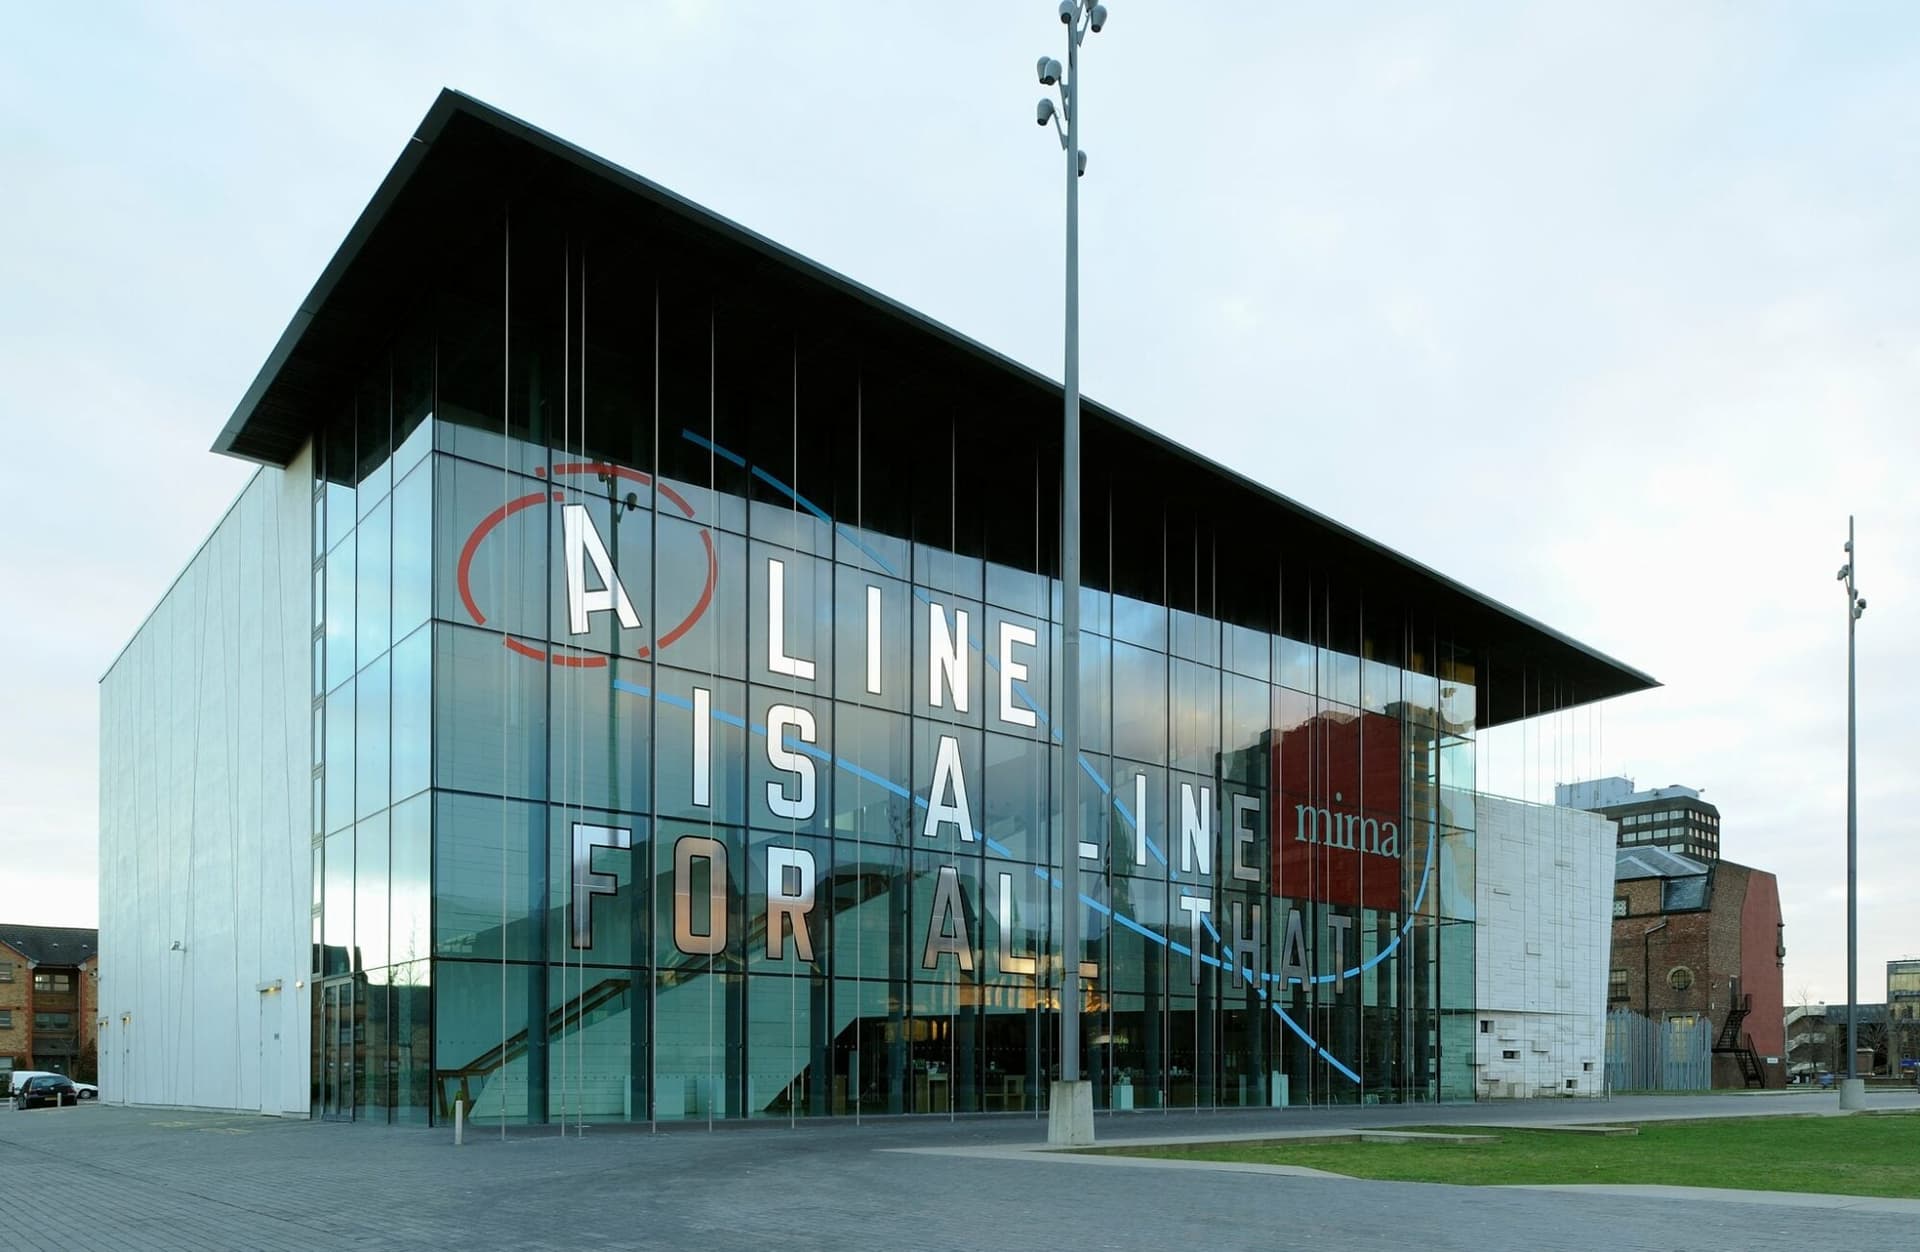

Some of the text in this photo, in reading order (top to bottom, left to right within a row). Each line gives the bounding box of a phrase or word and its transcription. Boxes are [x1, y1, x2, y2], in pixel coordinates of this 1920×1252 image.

[562, 503, 1037, 728] A LINE
[692, 686, 1261, 882] IS A INE
[1295, 791, 1401, 859] mima
[570, 821, 1352, 995] FOR AL THAT
